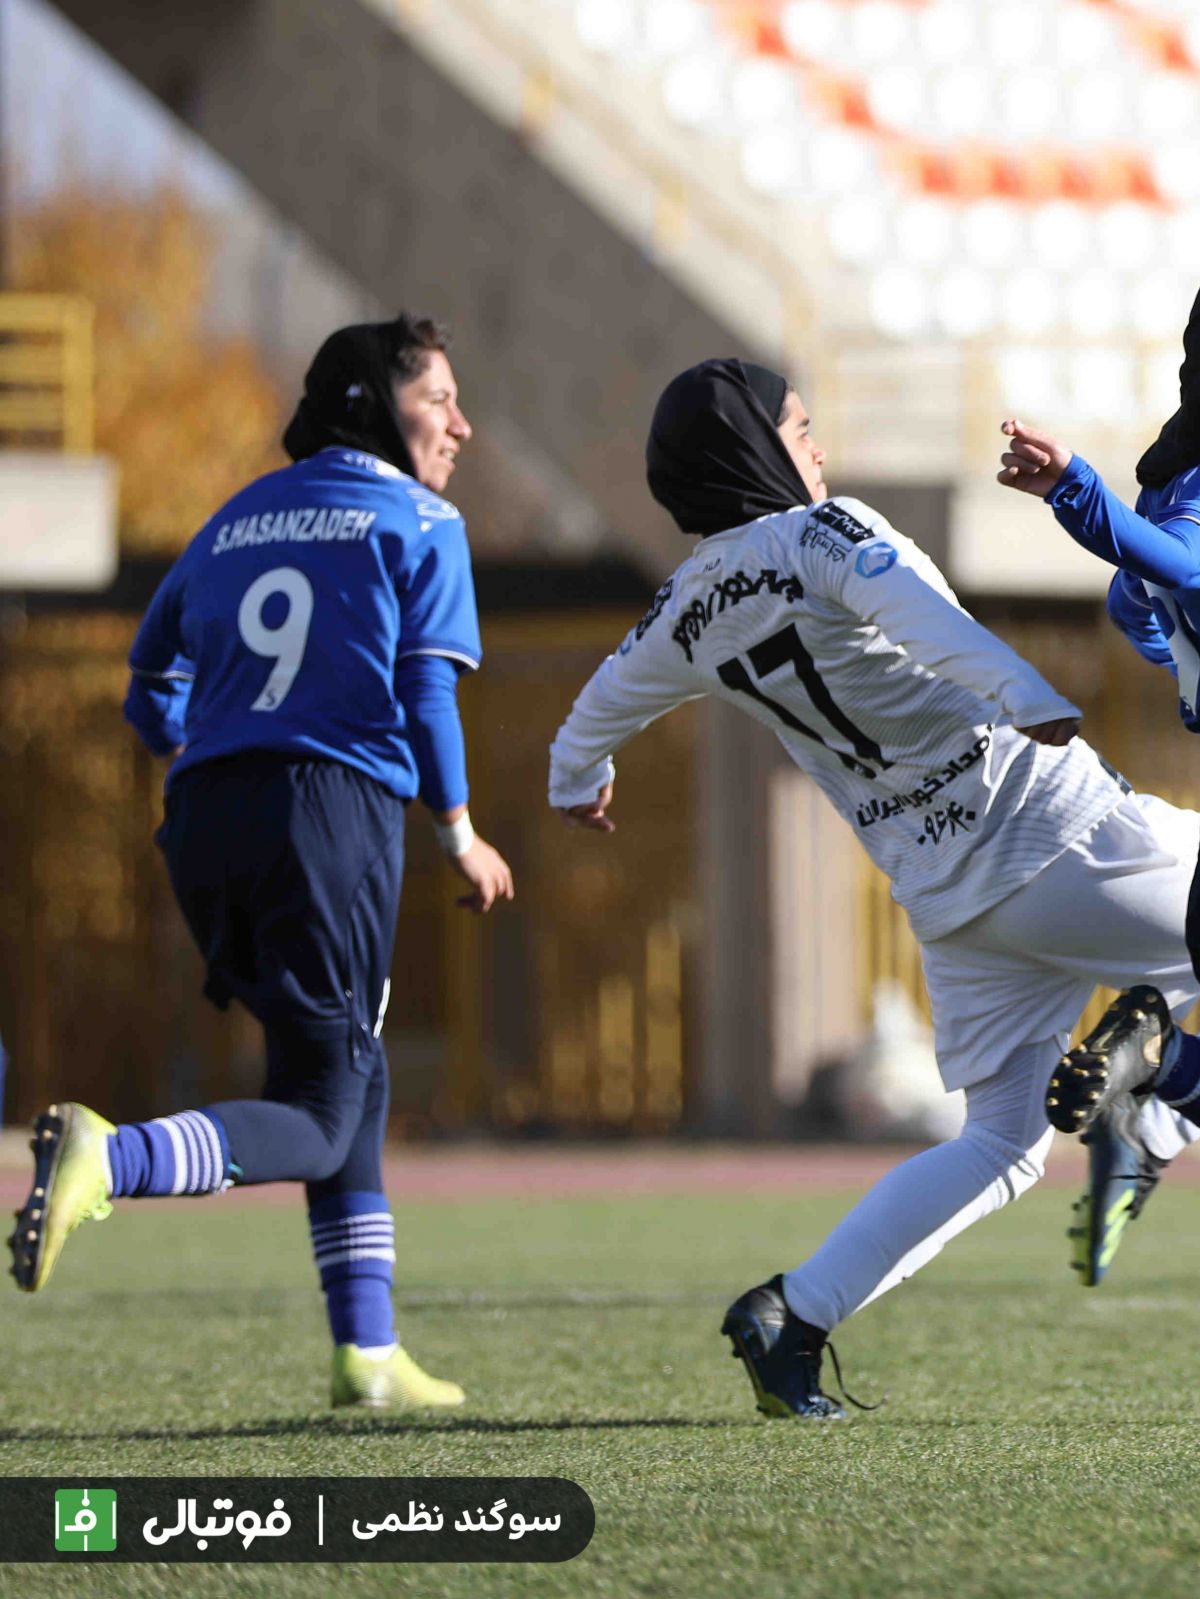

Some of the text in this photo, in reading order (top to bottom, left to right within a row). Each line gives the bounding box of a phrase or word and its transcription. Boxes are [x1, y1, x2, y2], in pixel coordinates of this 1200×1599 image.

[212, 507, 377, 555] S.HASANZADEH
[237, 566, 314, 712] 9
[716, 622, 896, 781] 17
[941, 723, 993, 783] مداد
